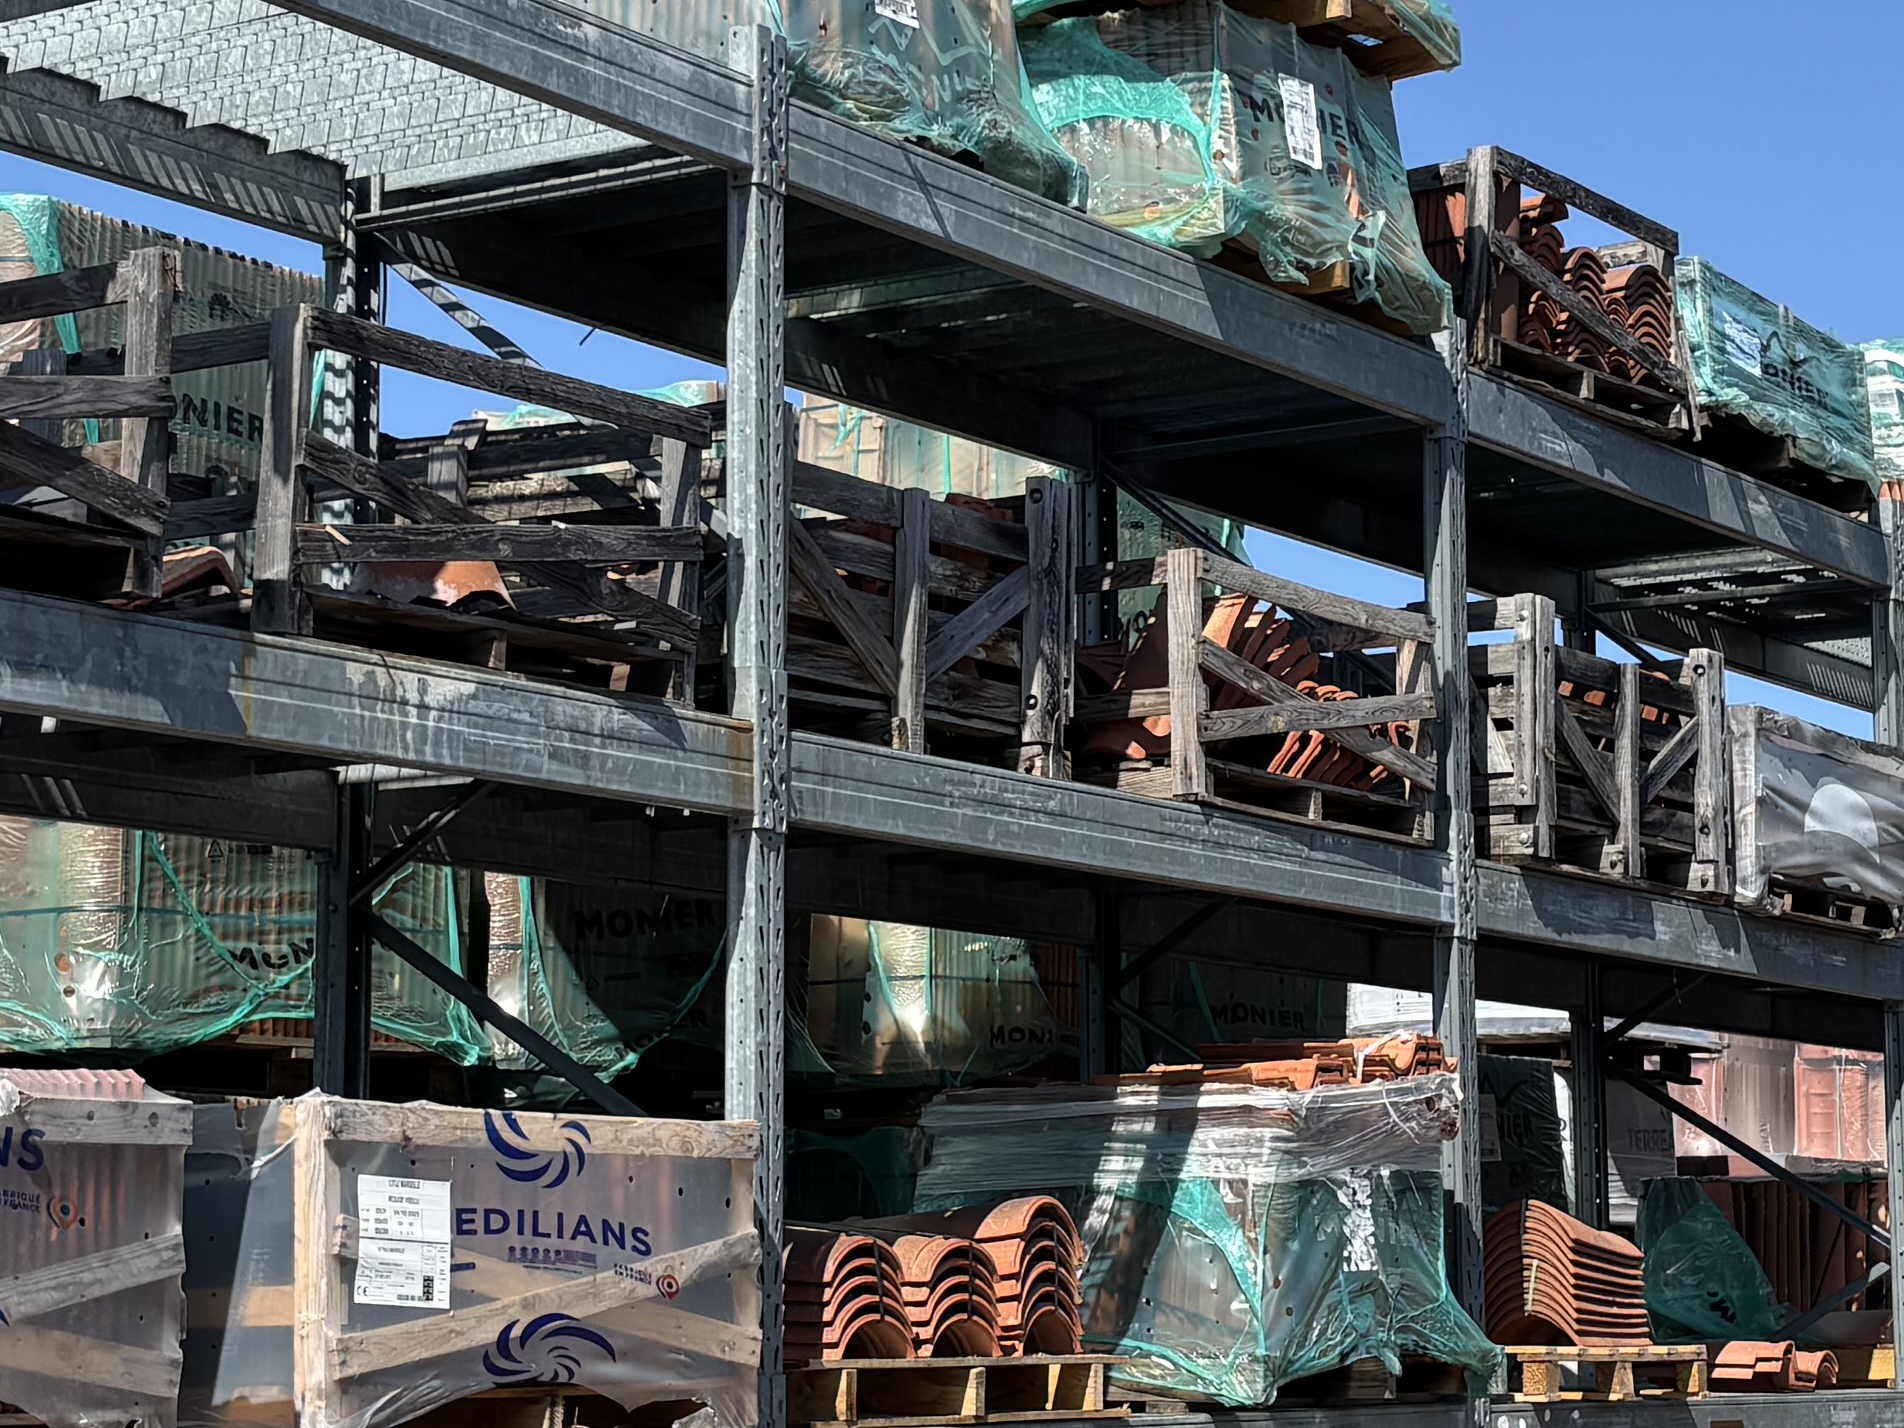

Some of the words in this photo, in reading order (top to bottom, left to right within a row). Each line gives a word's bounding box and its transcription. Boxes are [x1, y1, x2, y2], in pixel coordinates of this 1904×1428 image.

[1249, 93, 1368, 149] MIER
[181, 393, 264, 444] NIER
[989, 1025, 1053, 1049] MONI
[1212, 1002, 1305, 1031] MONIER
[1498, 1113, 1534, 1147] NIER
[455, 1208, 652, 1257] EDILIANS
